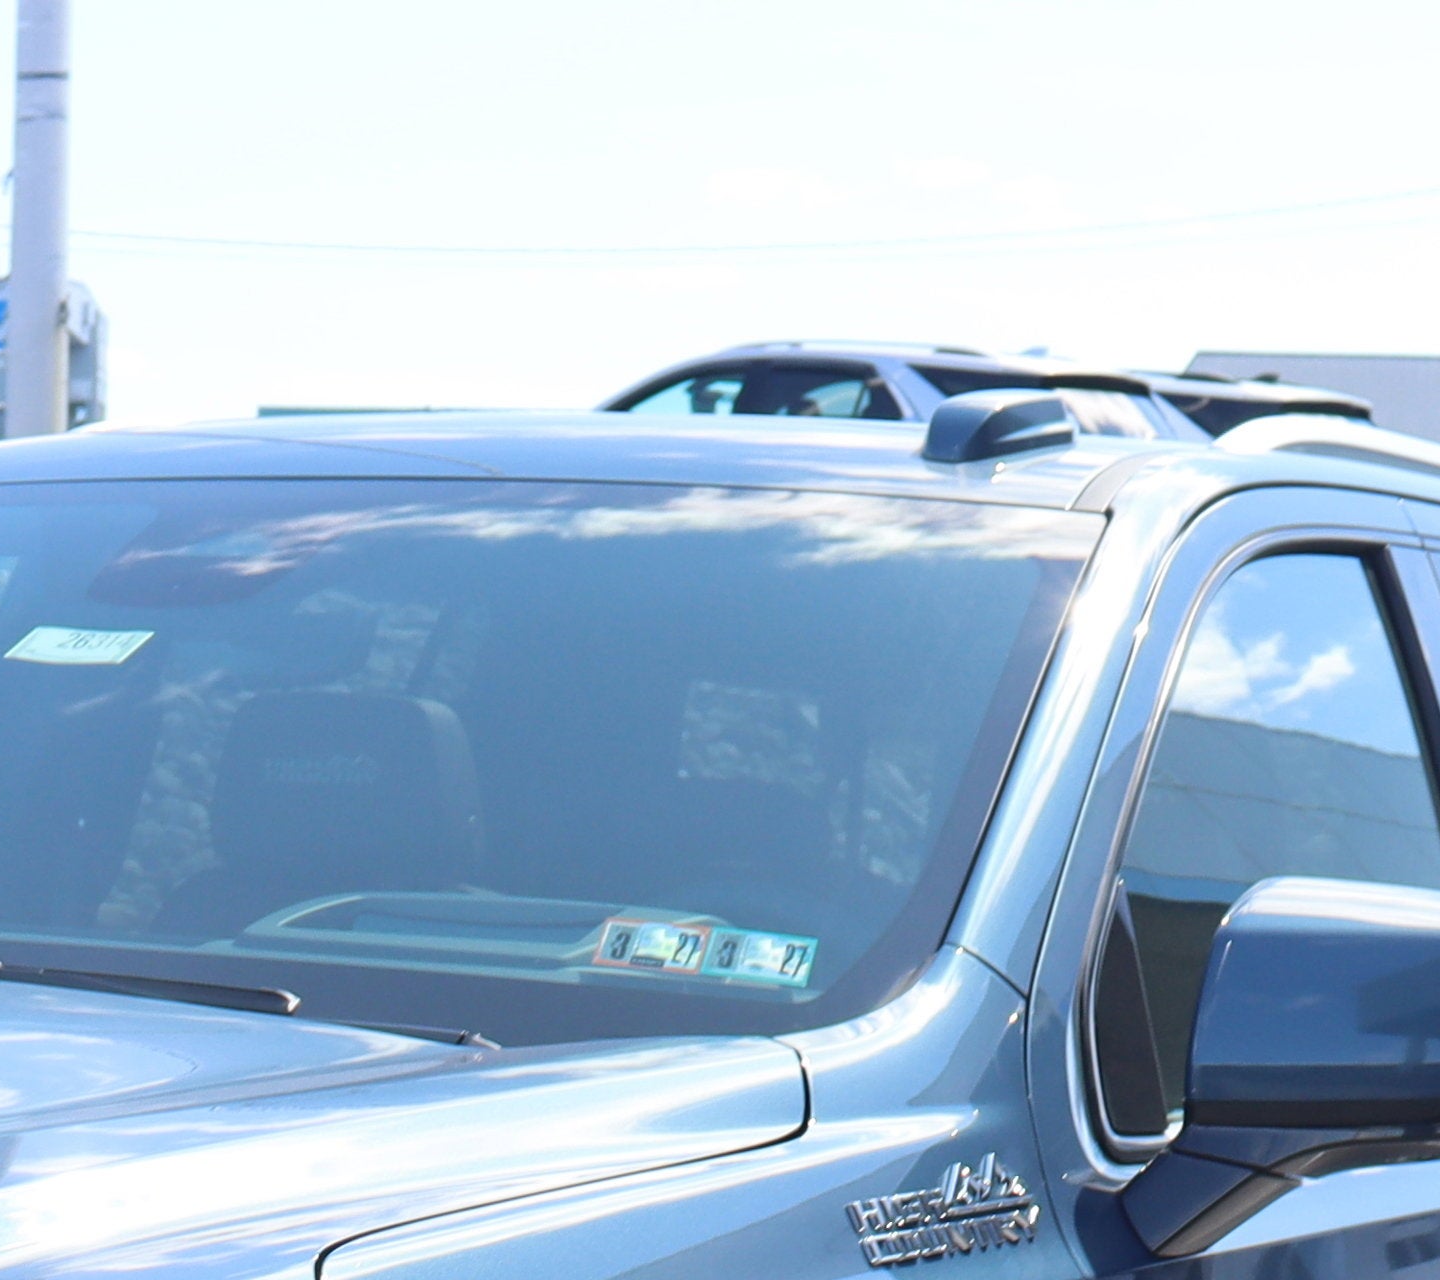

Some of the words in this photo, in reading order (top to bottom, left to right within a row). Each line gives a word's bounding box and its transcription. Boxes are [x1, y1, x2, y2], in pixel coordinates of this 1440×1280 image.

[610, 931, 631, 960] 3
[671, 932, 700, 966] 27
[720, 940, 738, 968] 3
[778, 943, 811, 979] 27
[858, 1206, 1040, 1266] COUNTRY
